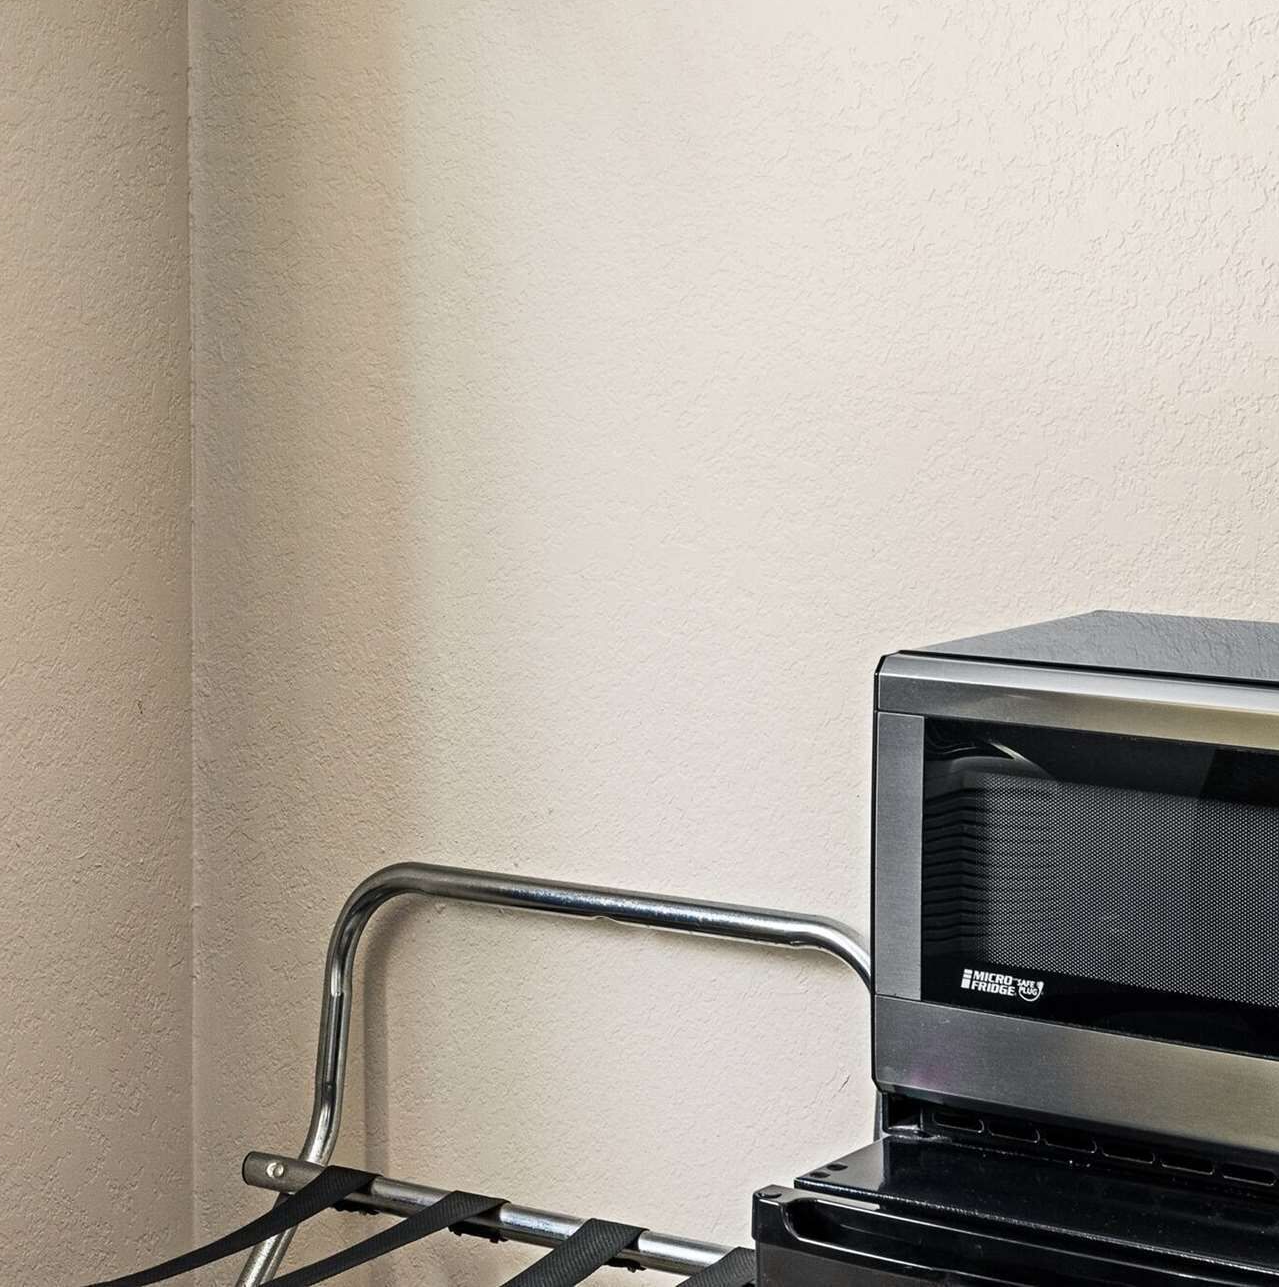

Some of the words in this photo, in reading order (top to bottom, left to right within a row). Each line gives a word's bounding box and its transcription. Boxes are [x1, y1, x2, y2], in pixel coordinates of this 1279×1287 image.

[972, 970, 1013, 985] MICRO
[1017, 979, 1035, 988] SAFE
[971, 980, 1016, 996] FRIDGE
[1020, 986, 1038, 996] PLUG
